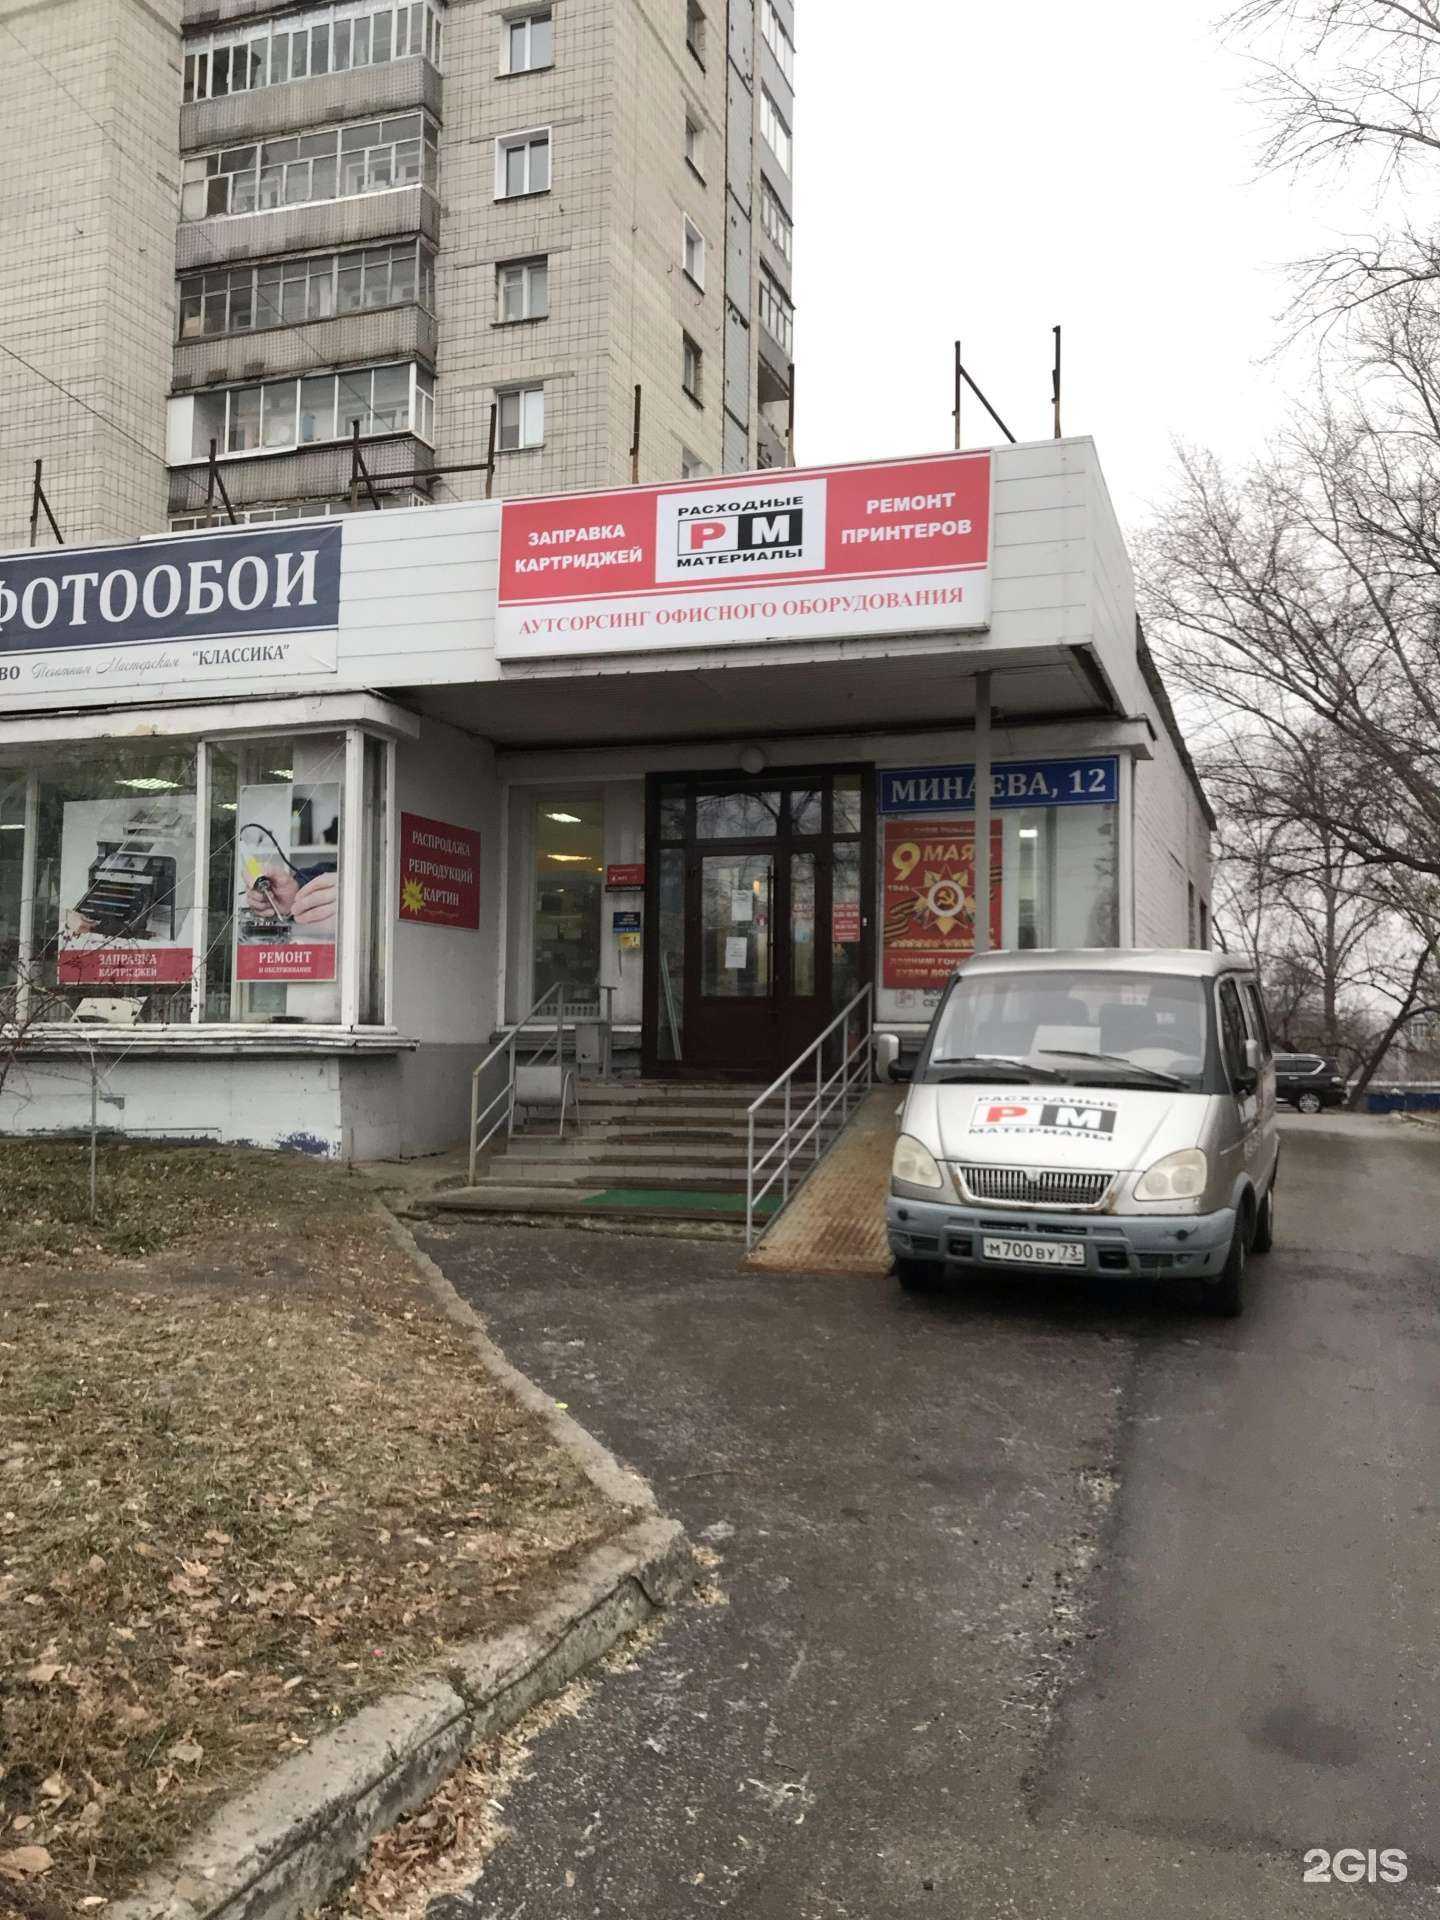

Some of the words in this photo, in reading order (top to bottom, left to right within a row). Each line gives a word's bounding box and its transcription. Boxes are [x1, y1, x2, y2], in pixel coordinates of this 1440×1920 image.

[678, 496, 804, 517] РАСХОДНЫЕ
[866, 492, 955, 515] РЕМОНТ
[527, 524, 625, 547] ЗАПРАВКА
[841, 519, 972, 544] ПРИНТЕРОВ
[514, 545, 643, 573] КАРТРИДЖЕЙ
[676, 548, 803, 568] МАТЕРИАЛЫ
[519, 610, 652, 636] АУТСОРСИНГ
[655, 601, 777, 626] ОФИСНОГО
[781, 586, 965, 618] ОБОРУДОВАНИЯ
[1069, 768, 1106, 794] 12
[412, 831, 471, 857] РАСПРОДАЖА
[408, 858, 473, 884] РЕПРОДУКЦИЙ
[892, 842, 920, 881] 9
[923, 844, 976, 861] МАЯ
[423, 886, 459, 906] КАРТИН
[259, 951, 312, 963] РЕМОНТ
[978, 1096, 1118, 1108] РАСХОДНЫЕ
[969, 1127, 1113, 1141] МАТЕРИАЛЫ
